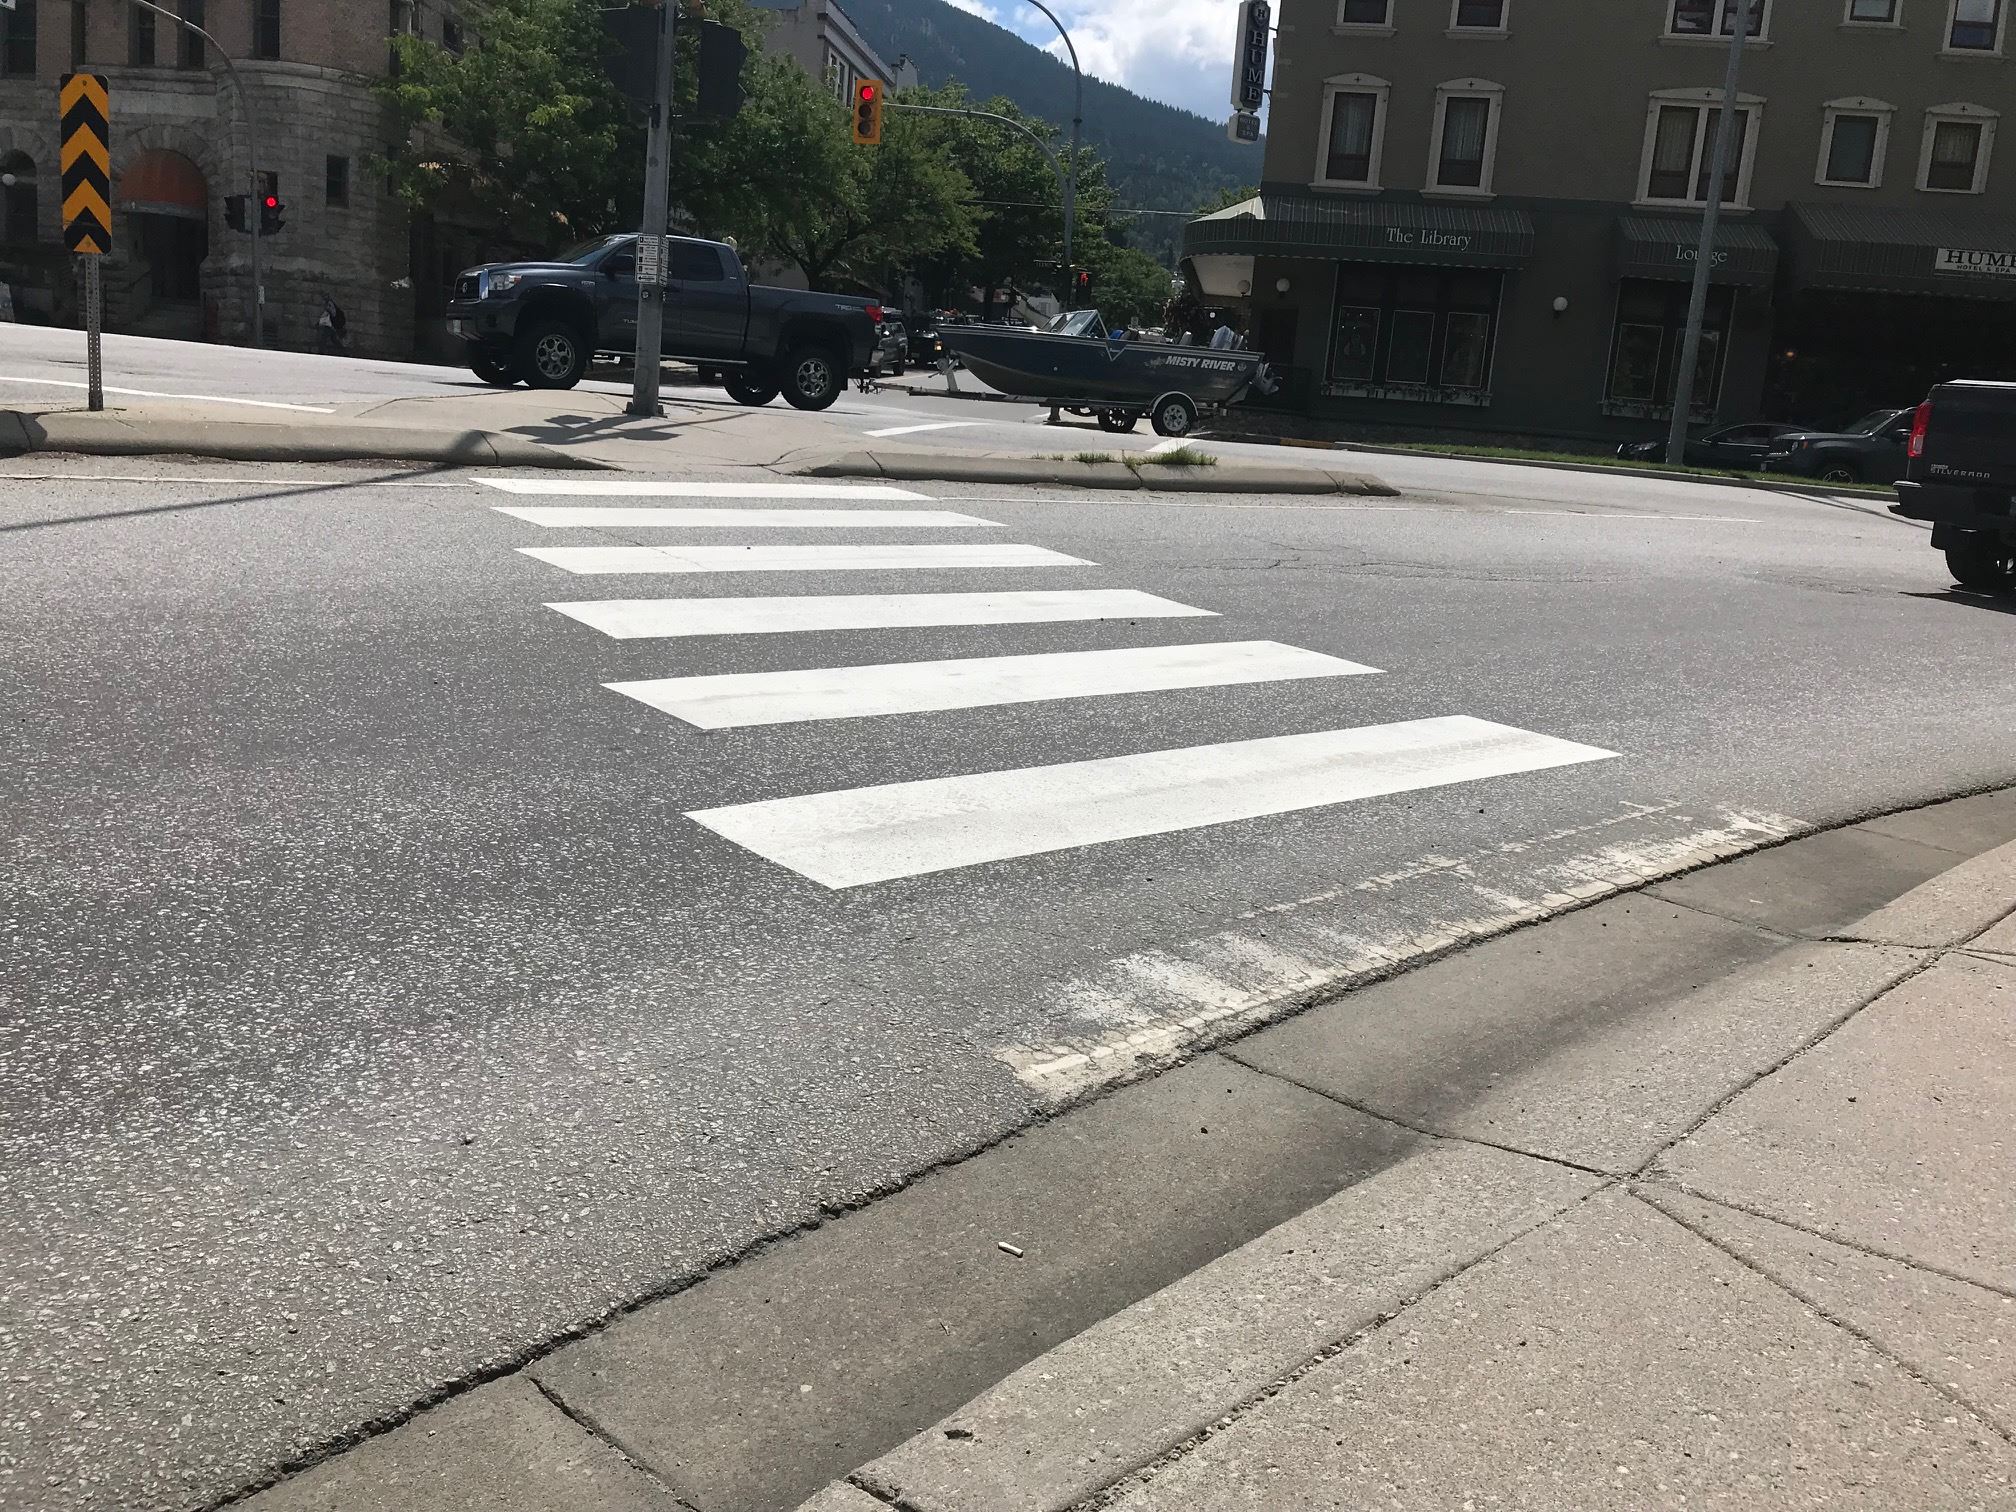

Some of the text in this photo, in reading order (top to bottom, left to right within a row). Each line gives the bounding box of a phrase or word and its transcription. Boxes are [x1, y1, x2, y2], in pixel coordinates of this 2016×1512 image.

[1248, 30, 1265, 101] HUME
[1387, 227, 1471, 251] The Library
[1165, 355, 1236, 371] MISTY RIVER
[1930, 467, 1991, 478] SILVERADO
